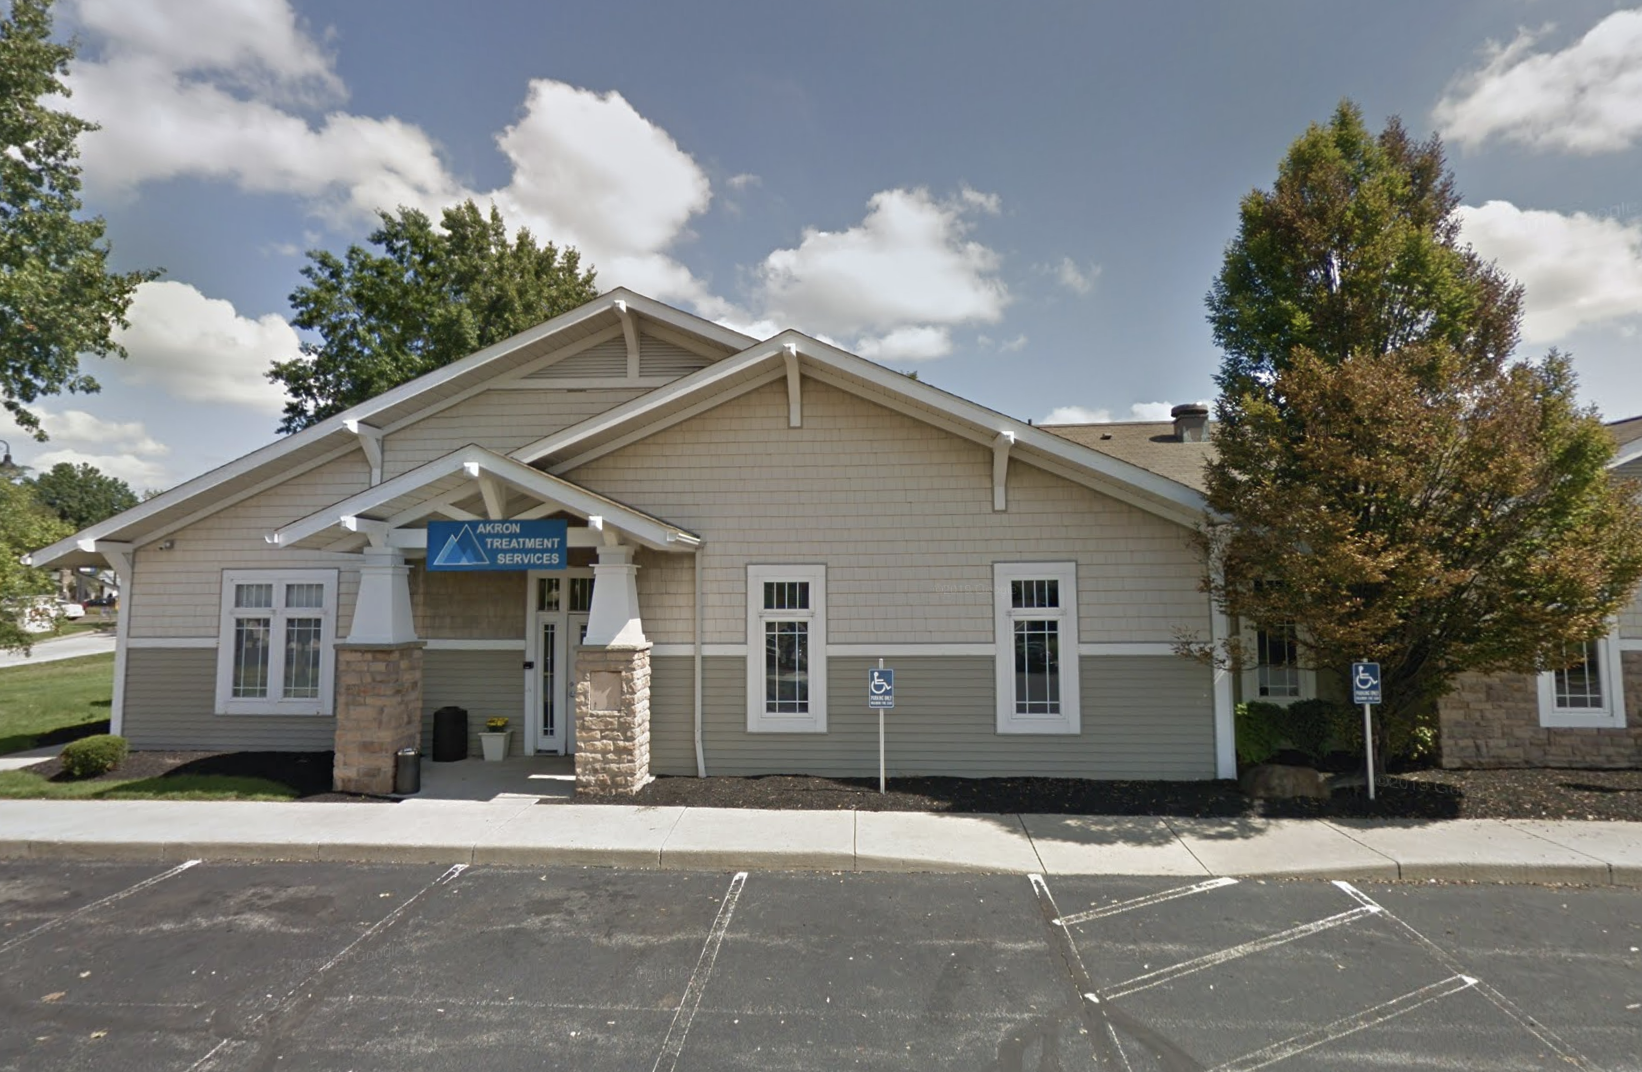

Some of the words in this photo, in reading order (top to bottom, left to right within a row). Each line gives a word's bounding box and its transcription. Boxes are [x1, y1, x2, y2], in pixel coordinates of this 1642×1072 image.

[476, 522, 521, 534] AKRON
[485, 538, 560, 549] TREATMENT
[497, 553, 560, 564] SERVICES
